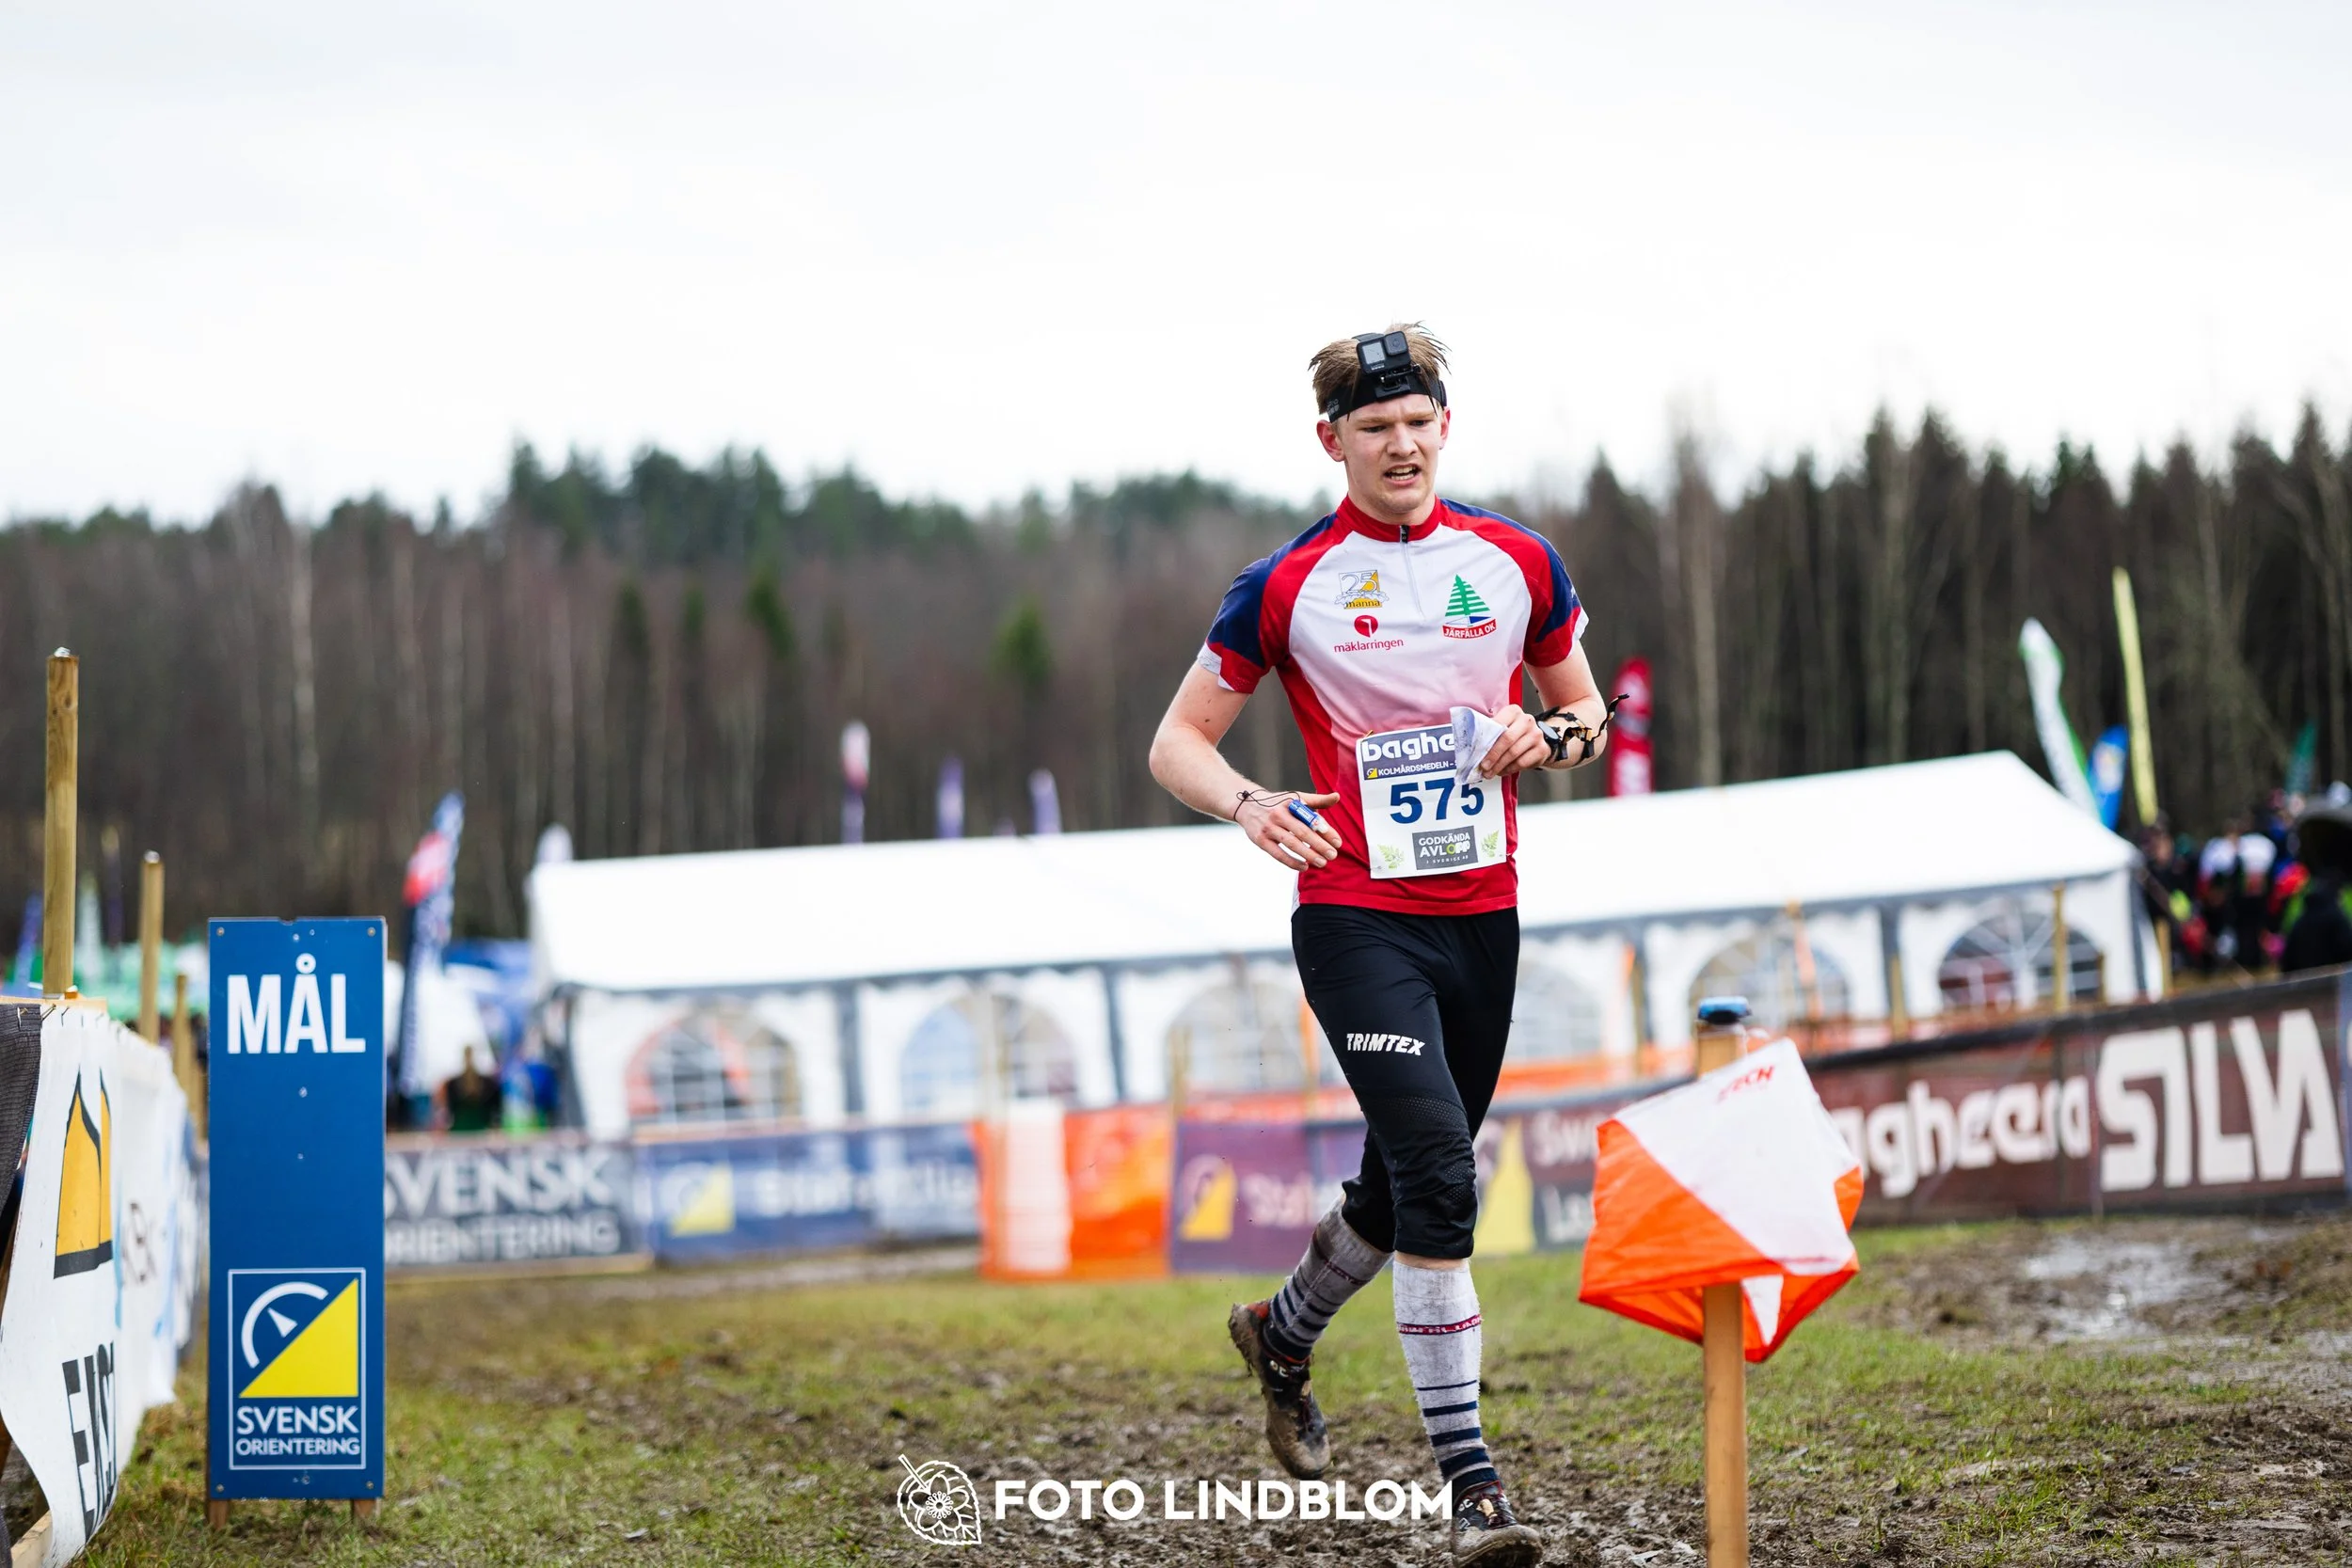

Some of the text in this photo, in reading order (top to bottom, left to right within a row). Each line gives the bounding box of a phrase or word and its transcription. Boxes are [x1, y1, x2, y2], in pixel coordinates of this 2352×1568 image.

[1341, 572, 1378, 594] 25
[1345, 600, 1381, 609] manna
[1444, 622, 1496, 639] JÄRFÄLLA OK
[1334, 639, 1404, 653] mäklarringen
[1378, 761, 1449, 777] KOLMÅRDSMEDELN
[1390, 777, 1485, 825] 575
[1418, 832, 1470, 846] GODKÄNDA
[1419, 840, 1471, 858] AVLOPP
[228, 952, 366, 1054] MÅL
[1346, 1033, 1425, 1055] TRIMTEX
[2097, 1007, 2344, 1193] SILVA
[236, 1404, 359, 1435] SVENSK
[235, 1437, 360, 1456] ORIENTERING
